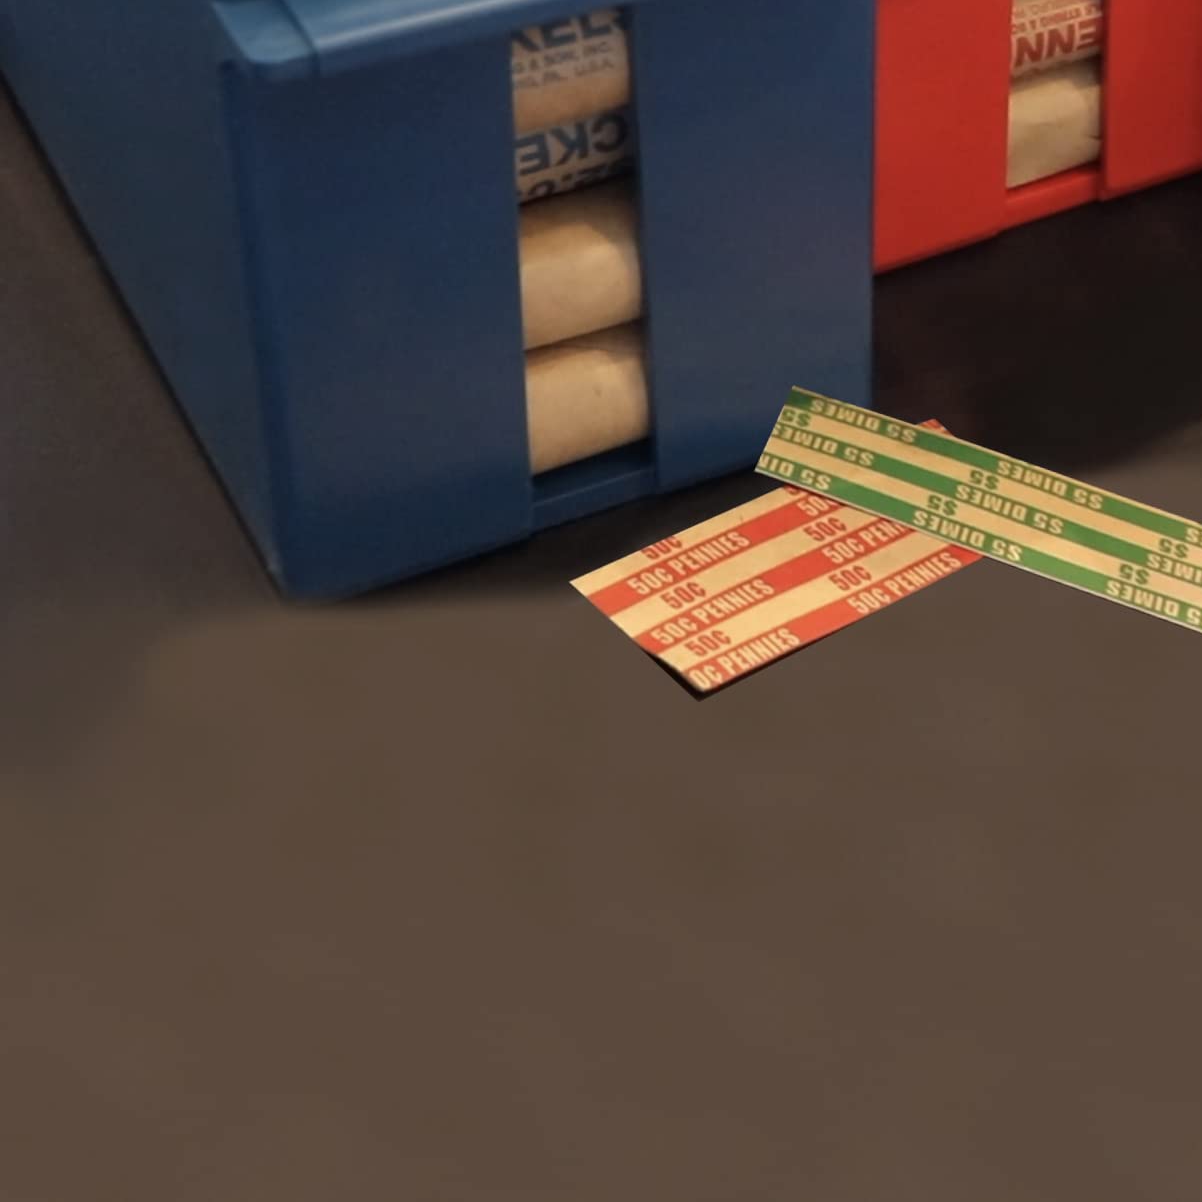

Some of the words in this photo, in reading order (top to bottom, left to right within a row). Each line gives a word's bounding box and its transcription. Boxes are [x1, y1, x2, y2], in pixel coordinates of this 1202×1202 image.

[809, 399, 881, 432] DIMES
[996, 458, 1068, 497] DIMES
[955, 484, 1028, 522] DIMES
[913, 510, 986, 548] DIMES
[667, 530, 751, 577] PENNIES
[883, 551, 962, 596] PENNIES
[691, 578, 775, 625] PENNIES
[1105, 578, 1181, 618] DIMES
[716, 626, 800, 675] PENNIES
